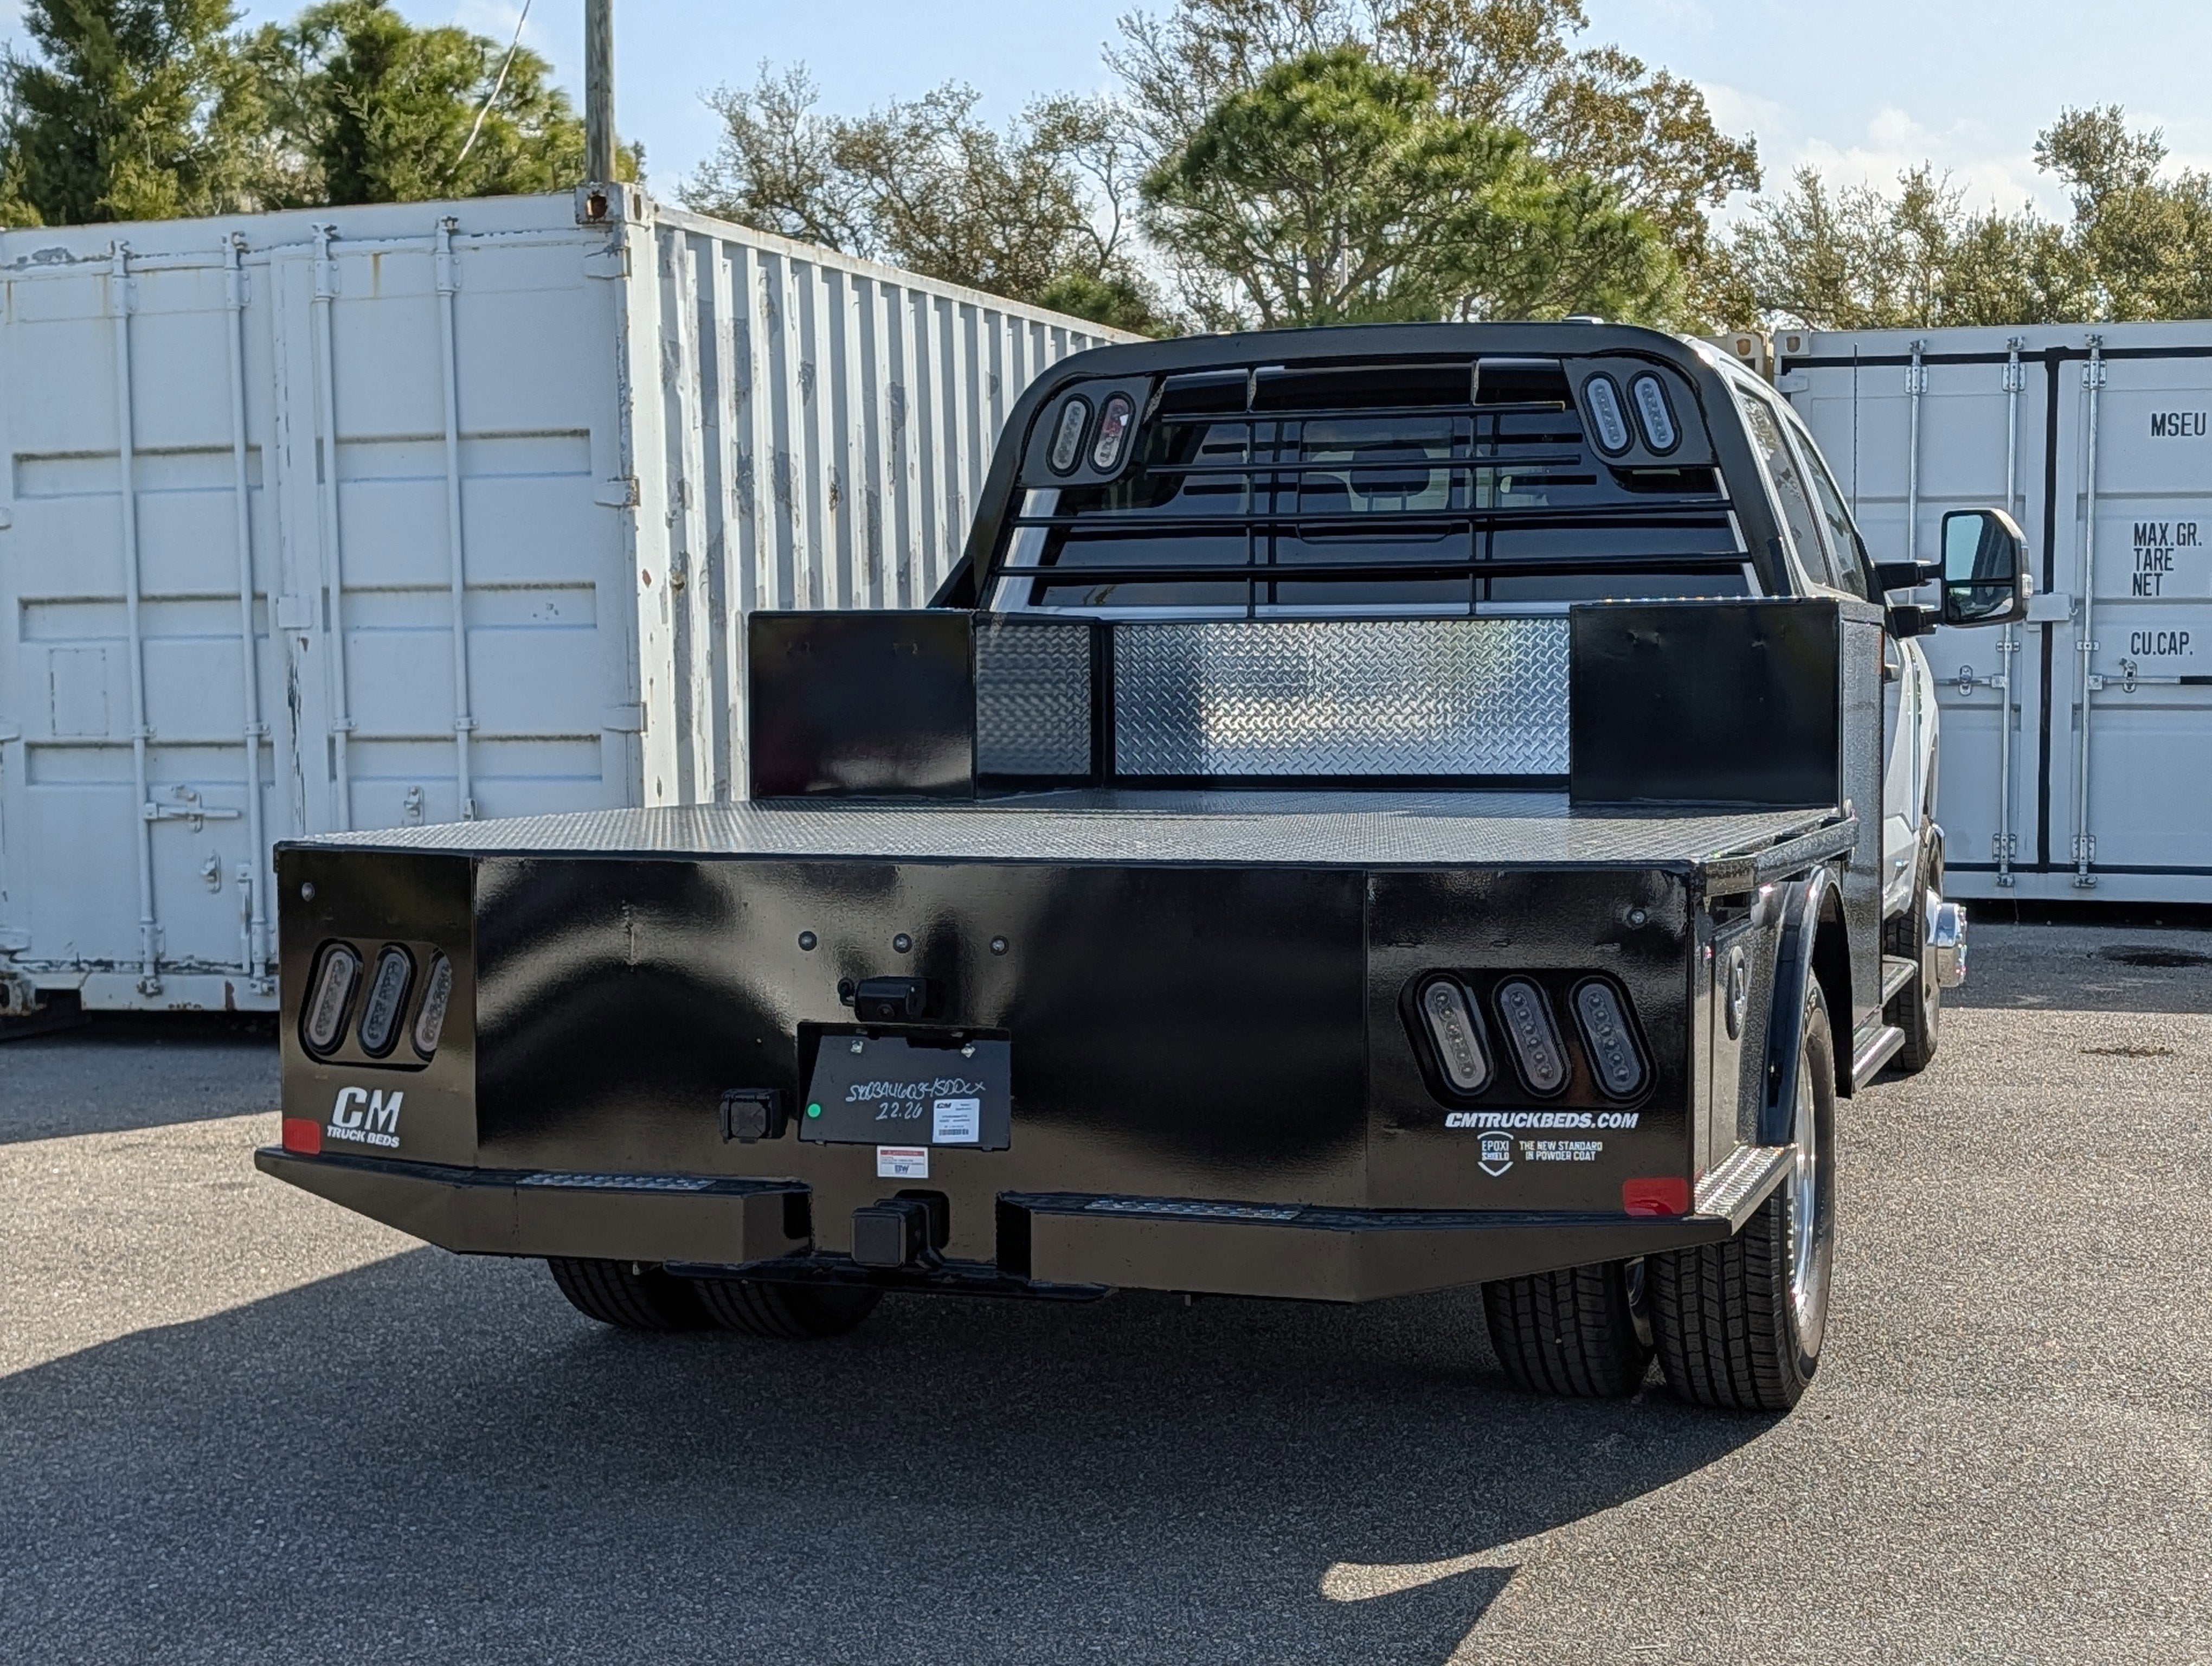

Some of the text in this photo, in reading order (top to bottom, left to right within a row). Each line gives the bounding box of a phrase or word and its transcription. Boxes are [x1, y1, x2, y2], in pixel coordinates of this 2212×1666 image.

[2151, 413, 2207, 437] MSEU
[2133, 548, 2174, 572] TARE
[2132, 573, 2163, 596] NET
[332, 1086, 404, 1133] CM
[1445, 1112, 1639, 1129] CMTRUCKBEDS.COM
[327, 1125, 400, 1148] TRUCK BEDS
[1482, 1140, 1509, 1151] EPOXI
[1519, 1140, 1603, 1151] THE NEW STANDARD
[1525, 1151, 1596, 1161] IN POWDER COAT
